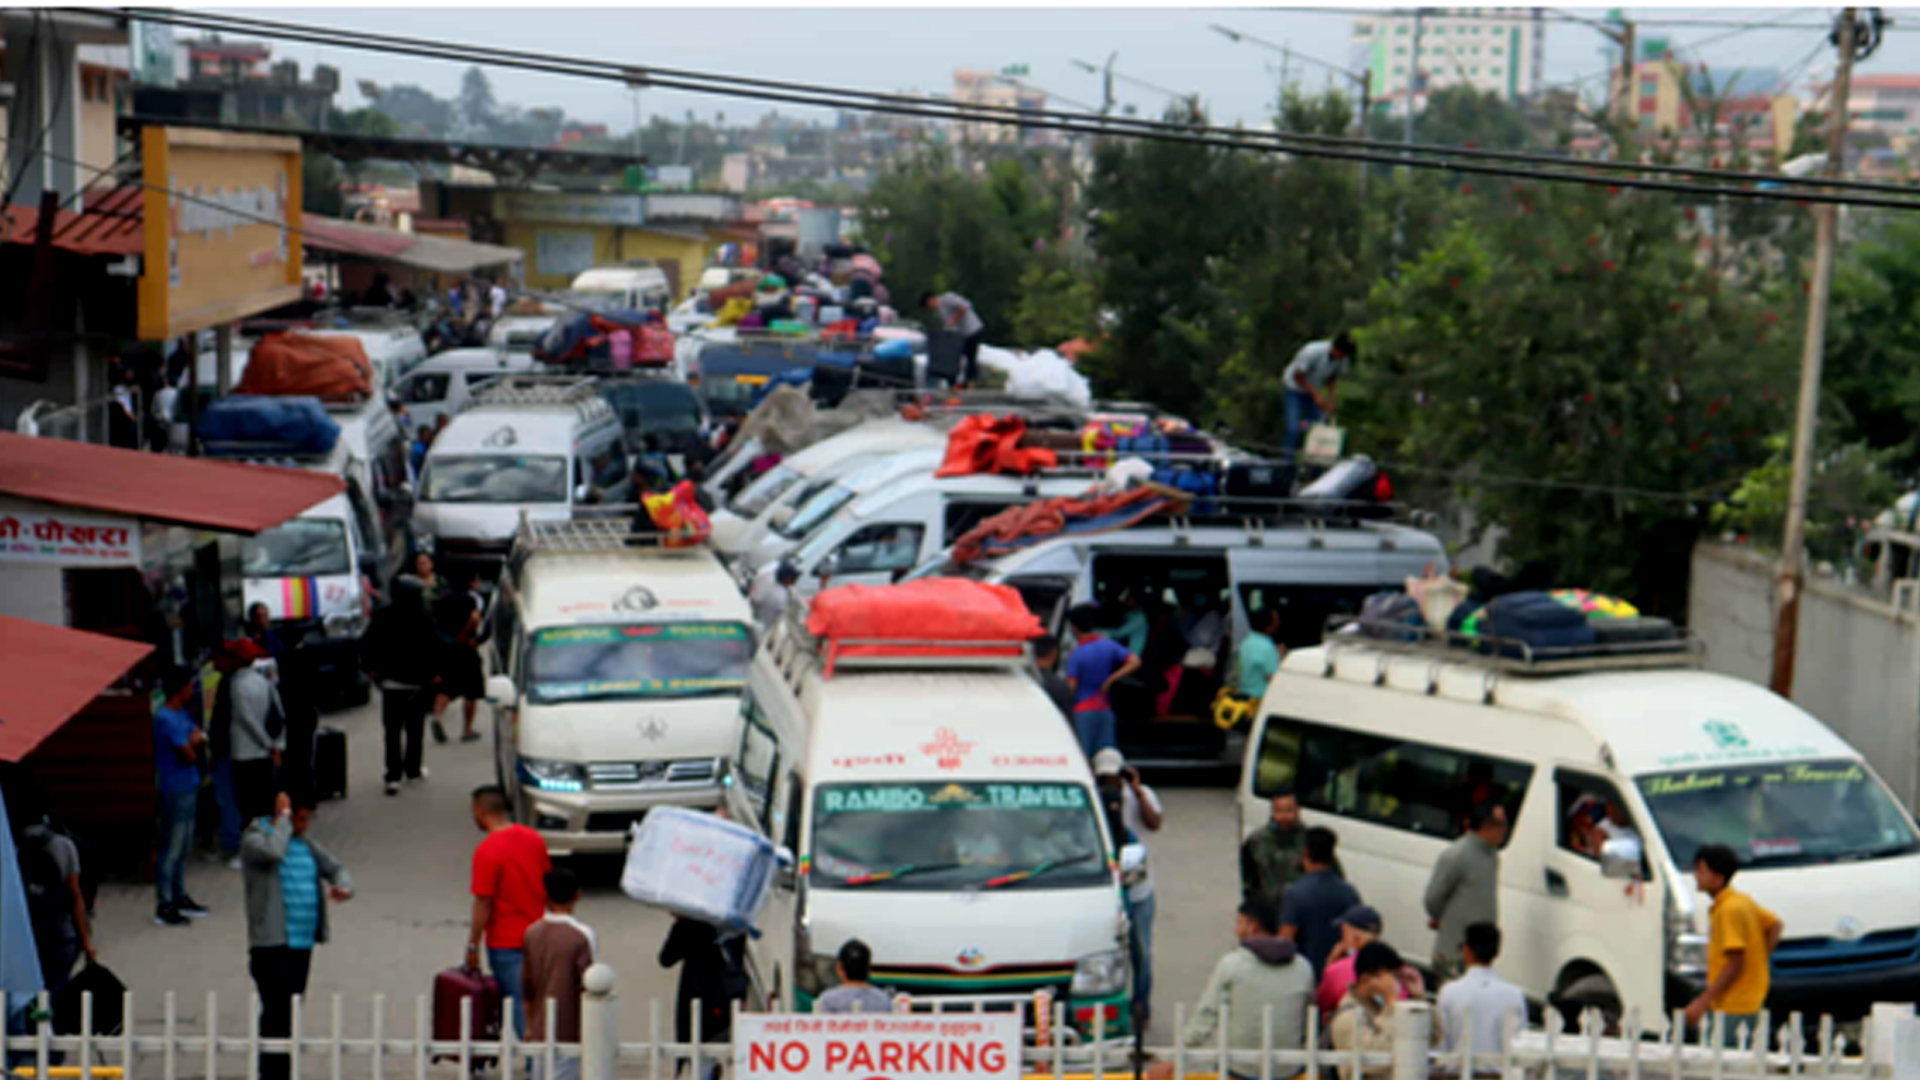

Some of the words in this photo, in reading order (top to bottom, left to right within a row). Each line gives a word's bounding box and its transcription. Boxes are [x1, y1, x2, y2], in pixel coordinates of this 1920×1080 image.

[825, 787, 925, 811] RAMBO
[986, 785, 1084, 808] TRAVELS
[749, 1040, 810, 1073] NO
[825, 1040, 1007, 1073] PARKING
